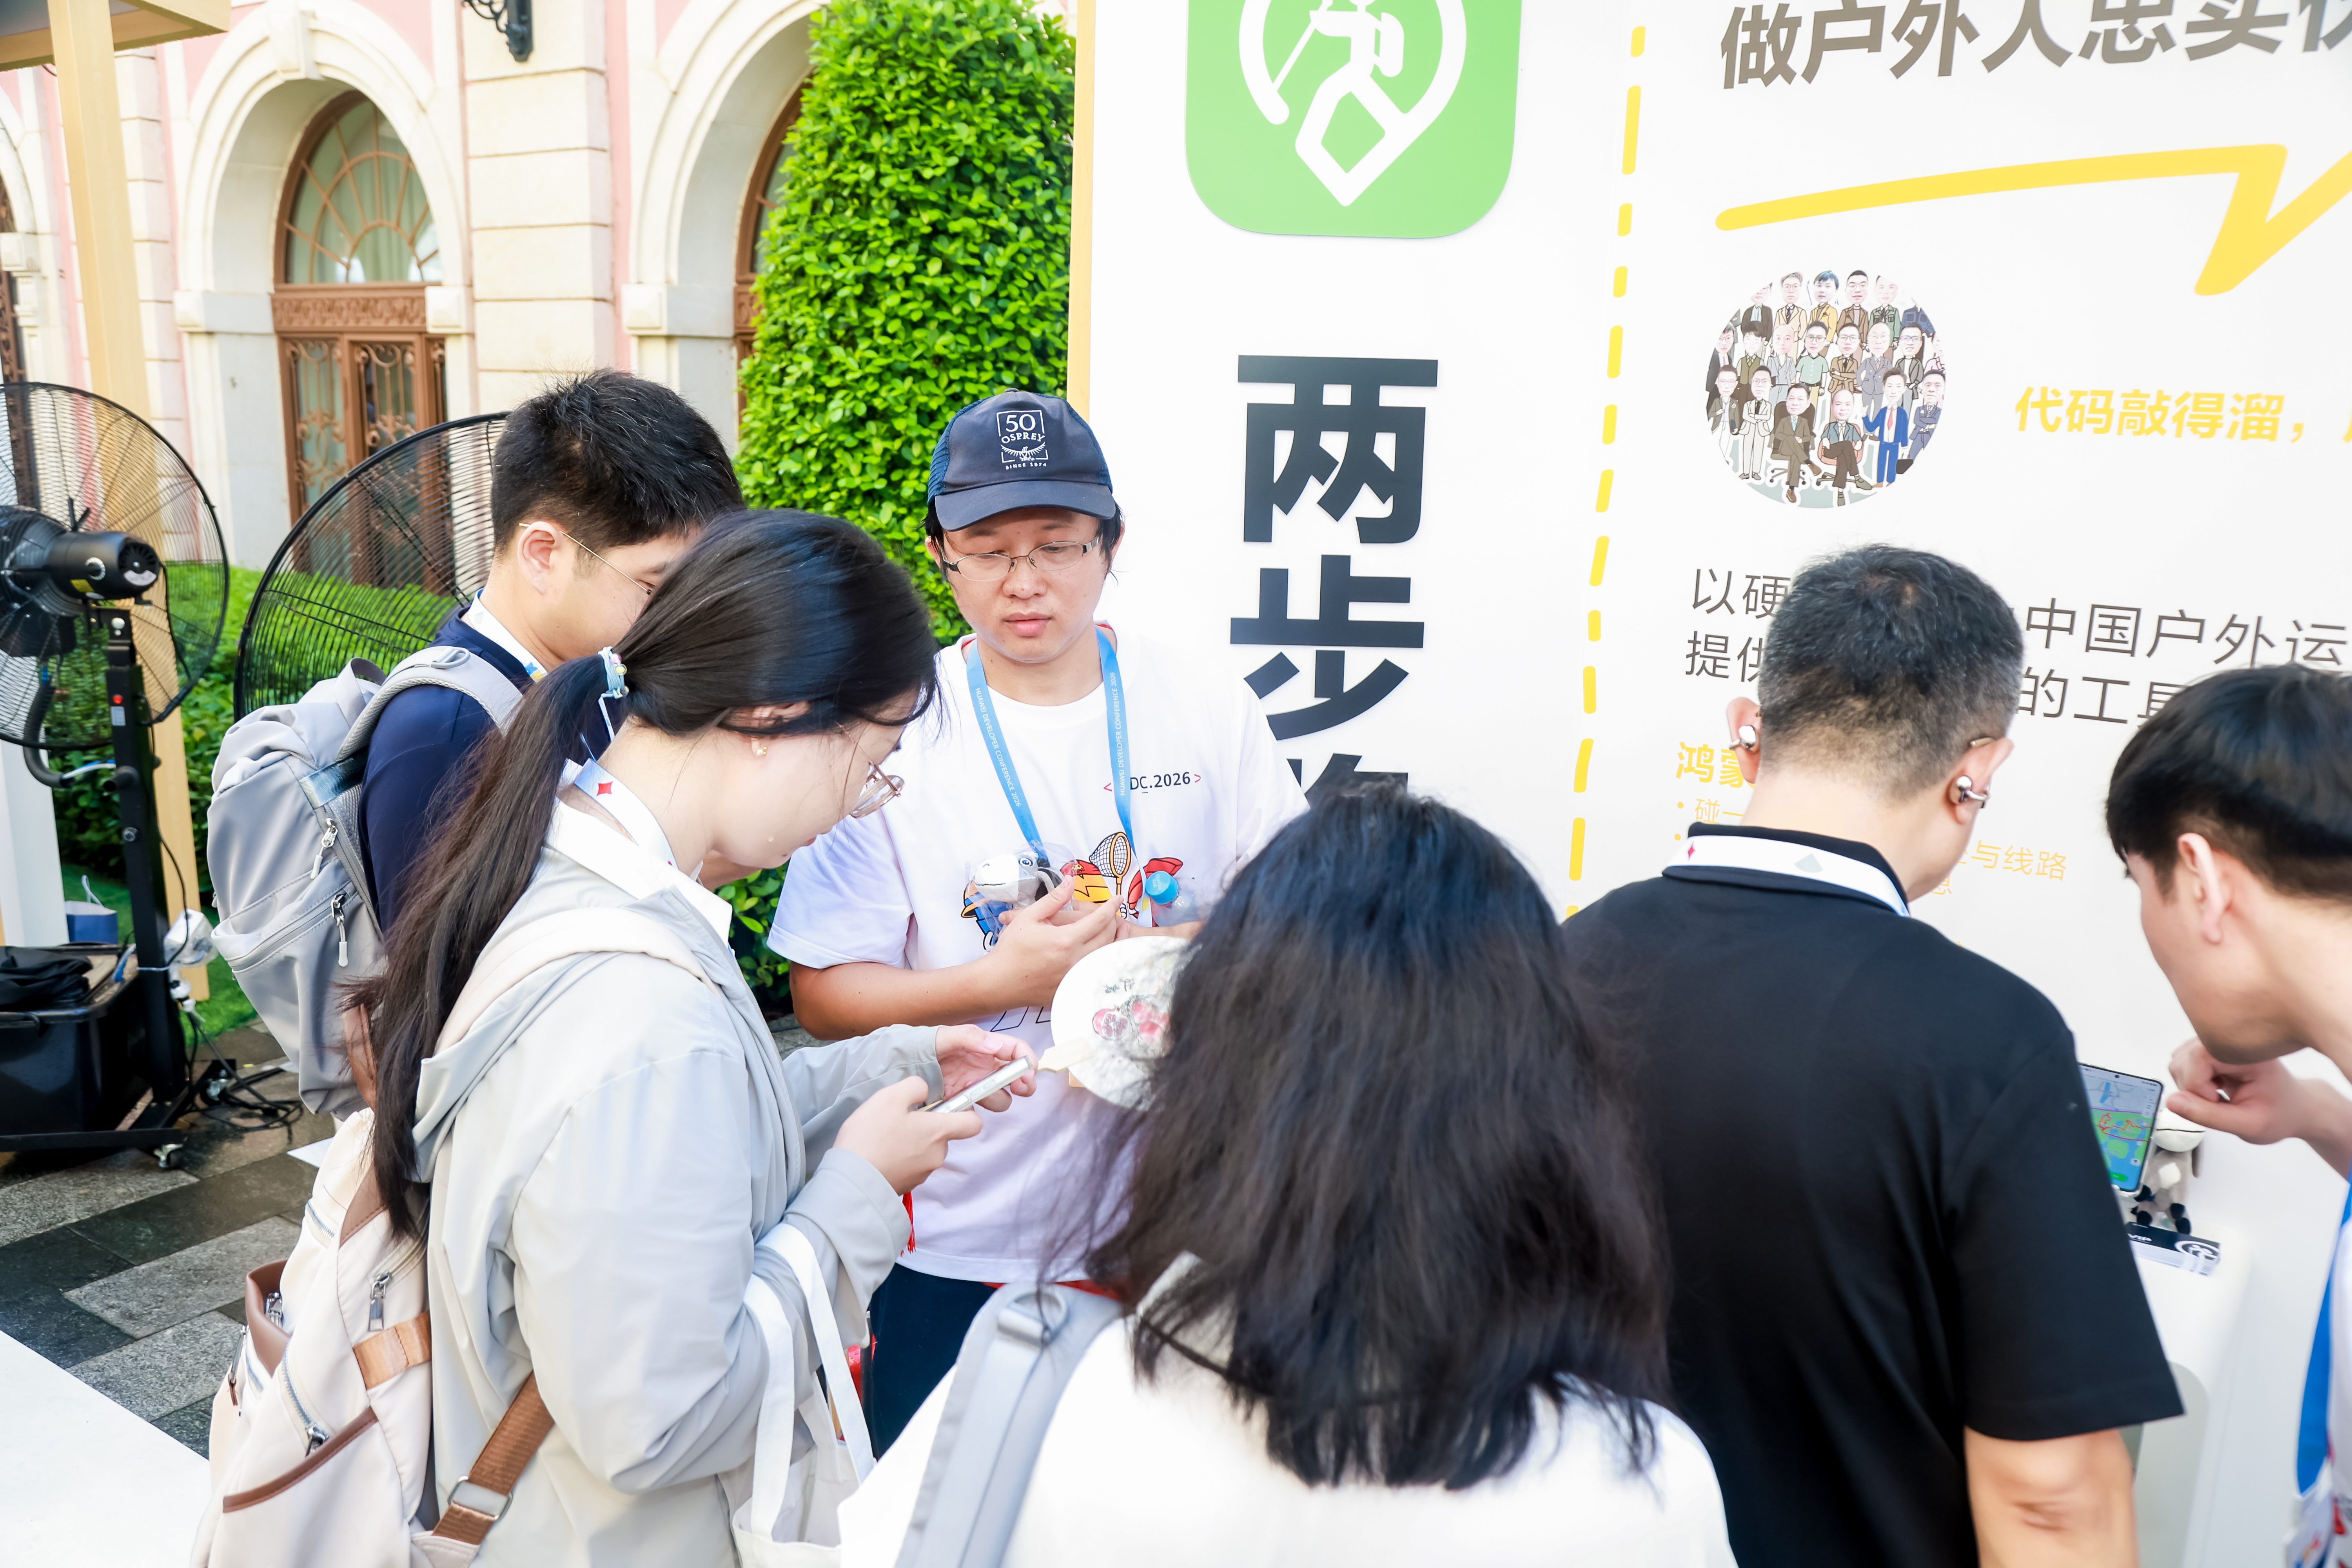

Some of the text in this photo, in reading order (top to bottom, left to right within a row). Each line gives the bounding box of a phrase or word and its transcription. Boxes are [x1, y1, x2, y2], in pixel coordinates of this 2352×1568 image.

[1005, 414, 1036, 432] 50
[2015, 386, 2352, 443] 代码敲得溜，
[1001, 432, 1045, 443] OSPREY
[1230, 355, 1438, 798] 两步
[1112, 688, 1122, 730] CONFERENCE
[975, 688, 1021, 807] HUAWEI DEVELOPER CONFERENCE 2026
[1116, 731, 1124, 768] DEVELOPER
[1958, 840, 2067, 880] 与线路
